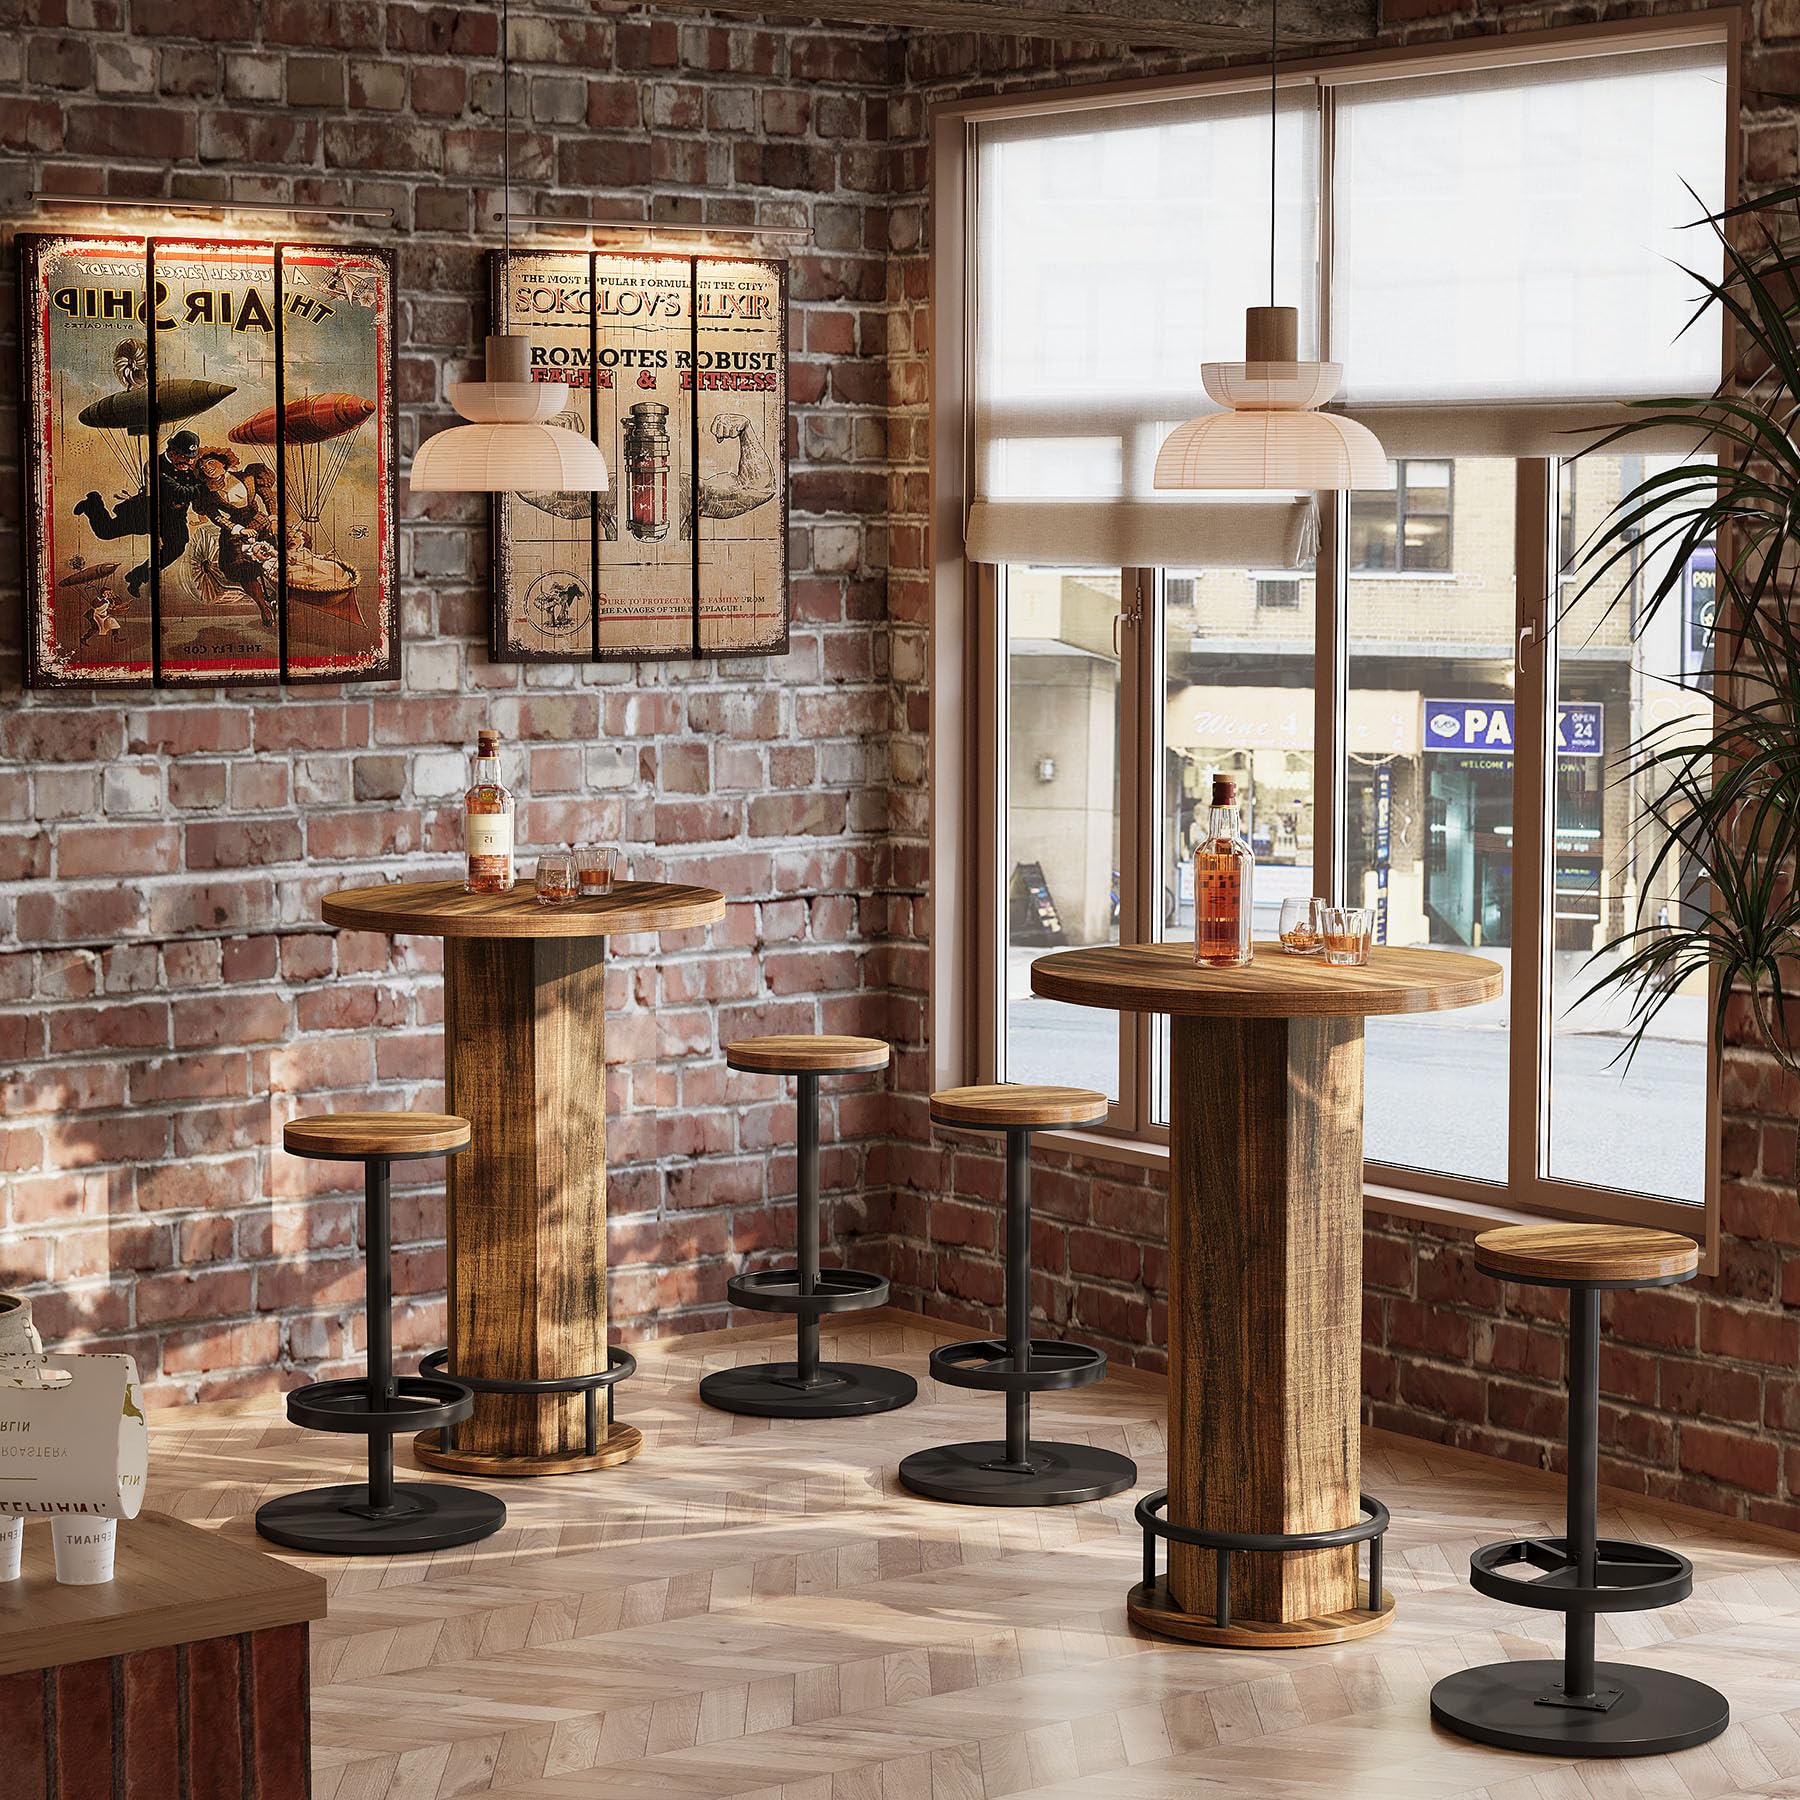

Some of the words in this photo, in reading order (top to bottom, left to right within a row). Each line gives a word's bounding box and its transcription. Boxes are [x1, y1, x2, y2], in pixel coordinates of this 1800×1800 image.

[548, 275, 583, 285] MOST
[640, 278, 692, 288] FORMUL
[714, 281, 735, 290] THE
[530, 346, 667, 368] ROMOTES
[674, 350, 777, 370] ROBUST
[530, 367, 614, 389] EALTH
[637, 369, 657, 390] &
[599, 592, 626, 606] SURE
[708, 596, 740, 604] FAMILY
[1571, 713, 1596, 724] OPEN
[1574, 724, 1593, 739] 24
[1460, 760, 1504, 769] WELCOME
